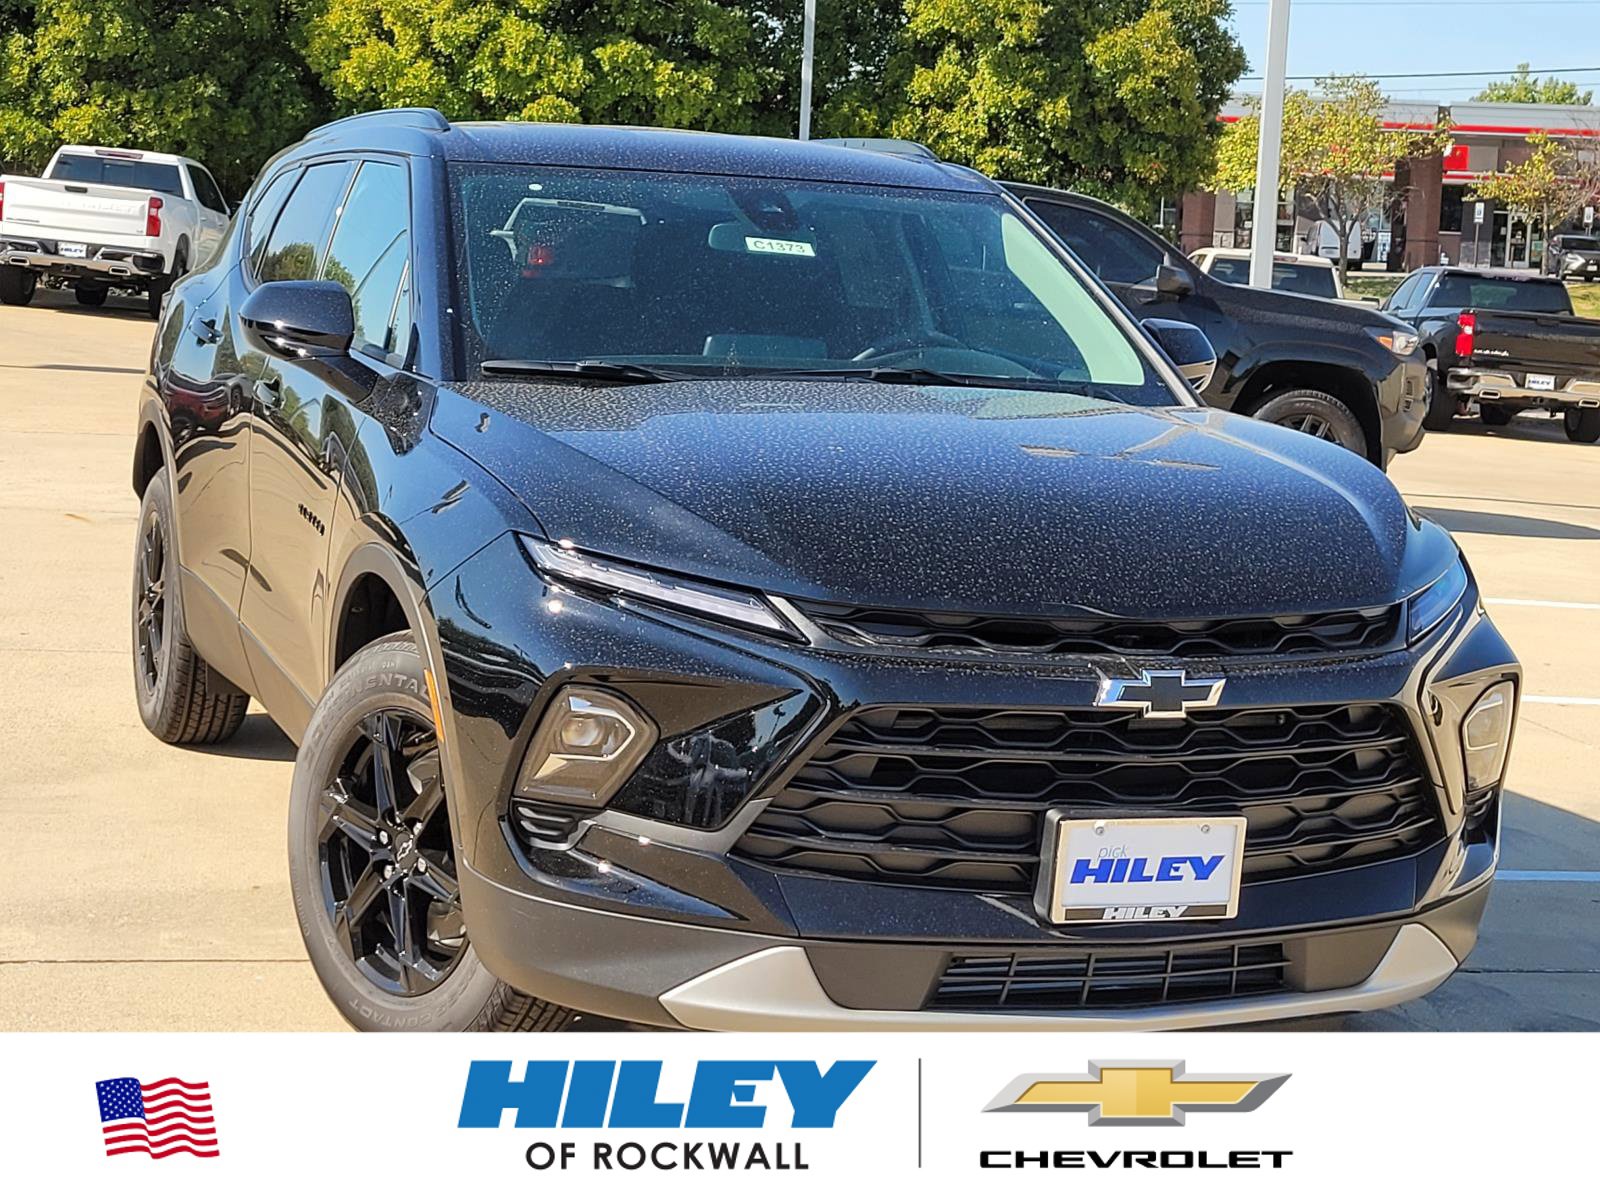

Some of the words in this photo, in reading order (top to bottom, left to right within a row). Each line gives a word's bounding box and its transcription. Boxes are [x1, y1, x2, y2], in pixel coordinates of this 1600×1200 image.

[753, 240, 805, 253] C1373
[1097, 845, 1128, 860] pick
[1070, 855, 1225, 884] HILEY
[1102, 905, 1189, 920] HILEY
